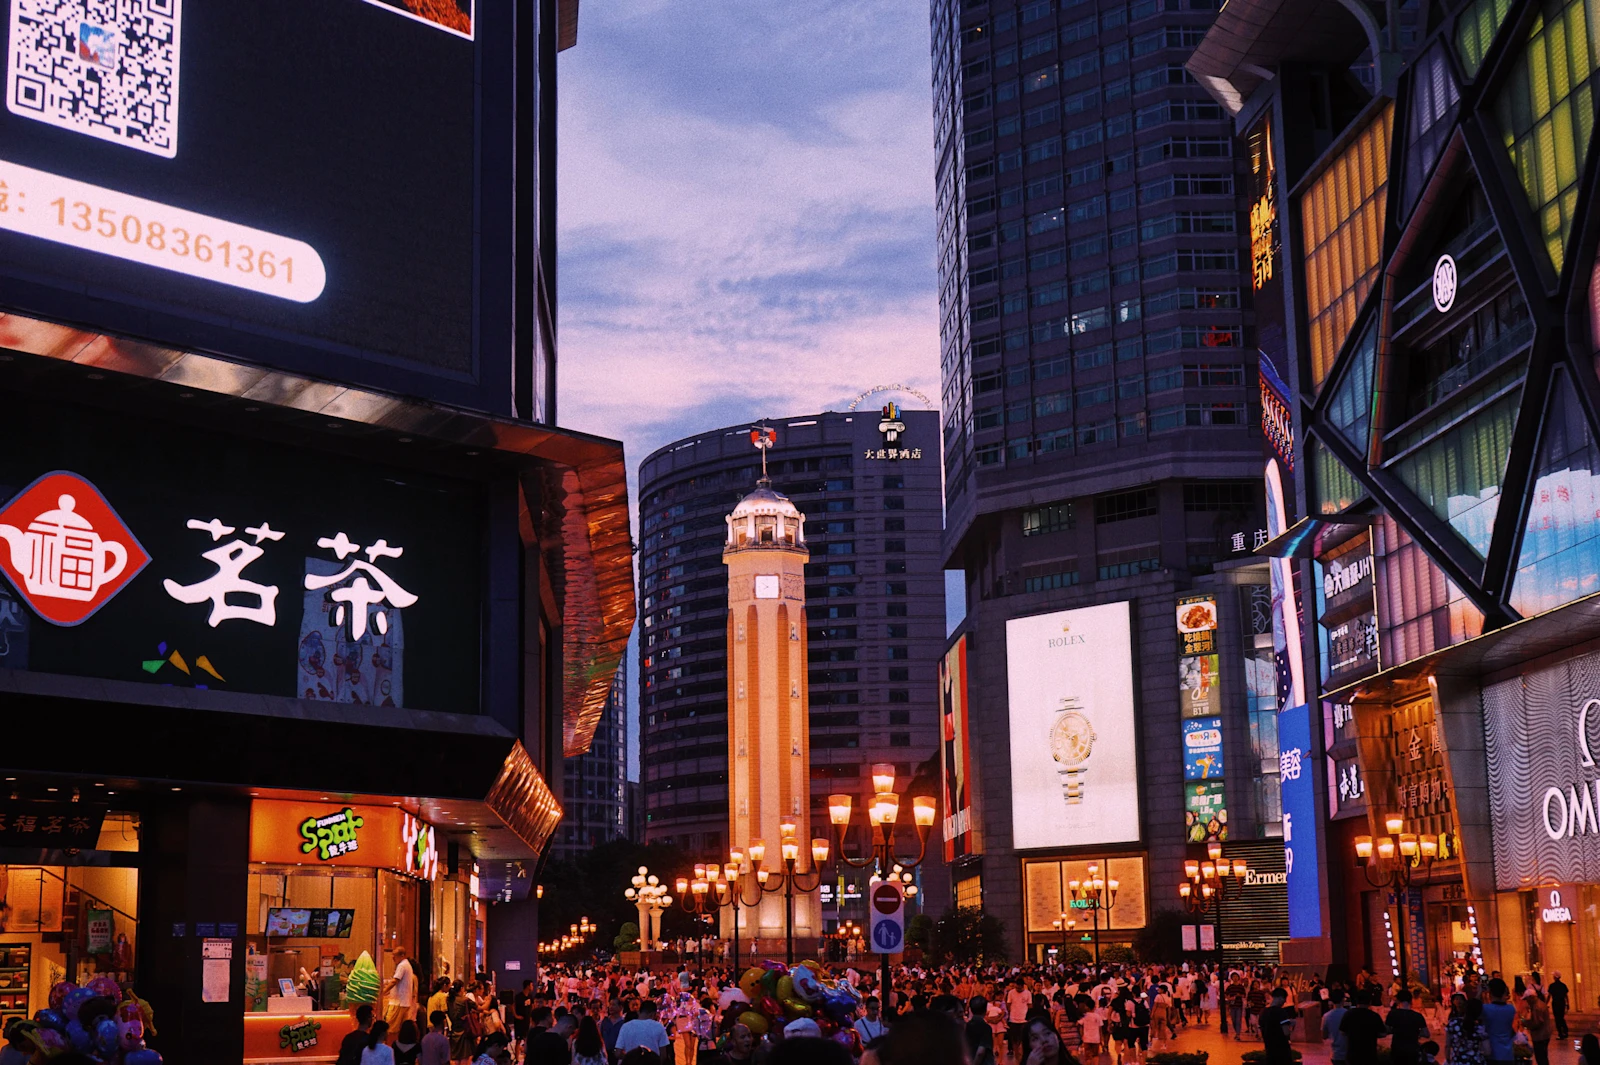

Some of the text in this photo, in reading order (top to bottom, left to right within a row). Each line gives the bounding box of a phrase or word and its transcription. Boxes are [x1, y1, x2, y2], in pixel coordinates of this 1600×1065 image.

[864, 448, 922, 459] 大世界酒店
[1231, 529, 1268, 552] 重庆
[163, 518, 419, 641] 茗茶
[1048, 634, 1086, 649] ROLEX
[1543, 779, 1600, 840] OM
[1542, 908, 1572, 923] OMEGA
